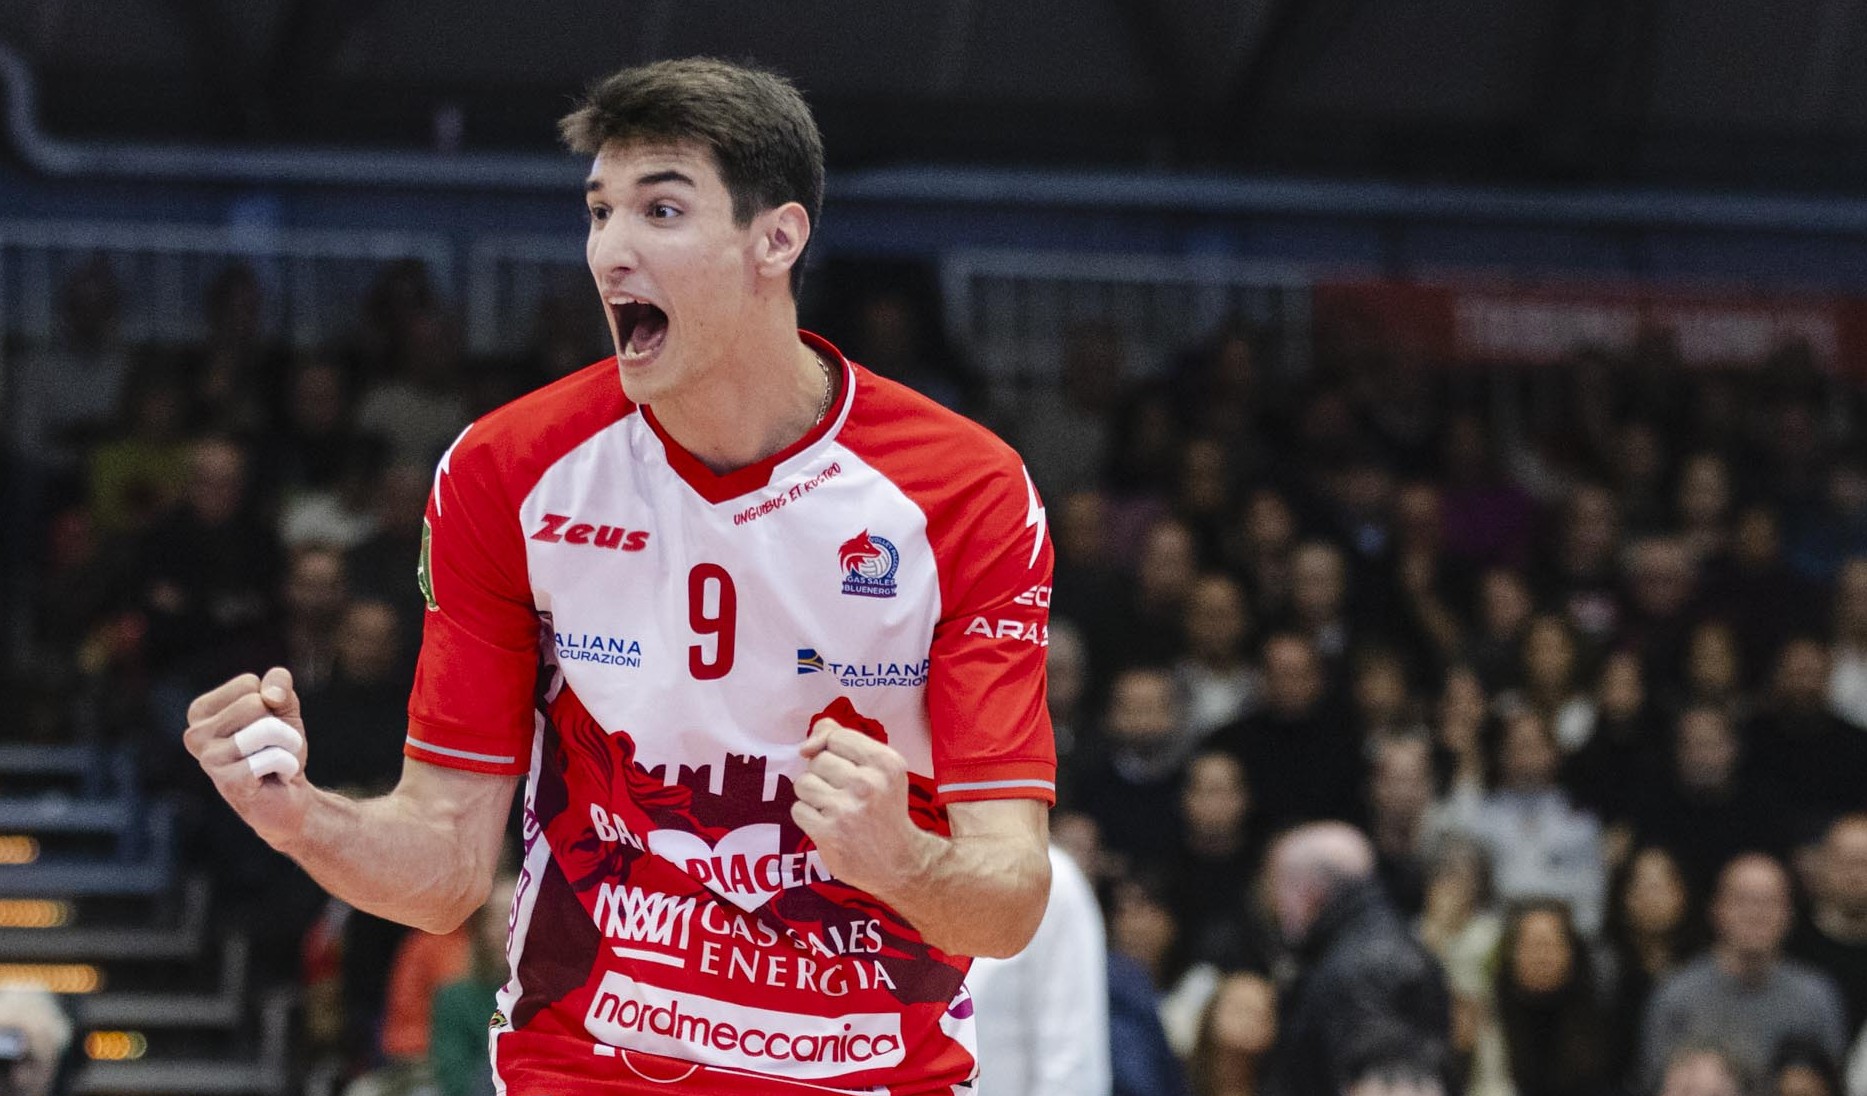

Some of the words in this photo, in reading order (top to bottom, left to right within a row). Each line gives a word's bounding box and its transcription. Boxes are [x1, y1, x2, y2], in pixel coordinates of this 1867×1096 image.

[733, 493, 787, 526] UNGUIBUS
[789, 483, 802, 502] ET
[804, 461, 842, 492] ROSTRO
[531, 514, 650, 552] Zeus
[844, 584, 895, 595] BLUENERGY
[847, 576, 866, 584] GAS
[867, 577, 895, 586] SALES
[688, 563, 736, 680] 9
[827, 658, 930, 677] TALIANA
[590, 802, 646, 853] BA
[700, 900, 778, 948] GAS
[785, 918, 882, 959] SALES
[700, 941, 897, 997] ENERGIA
[594, 988, 900, 1064] nordmeccanica
